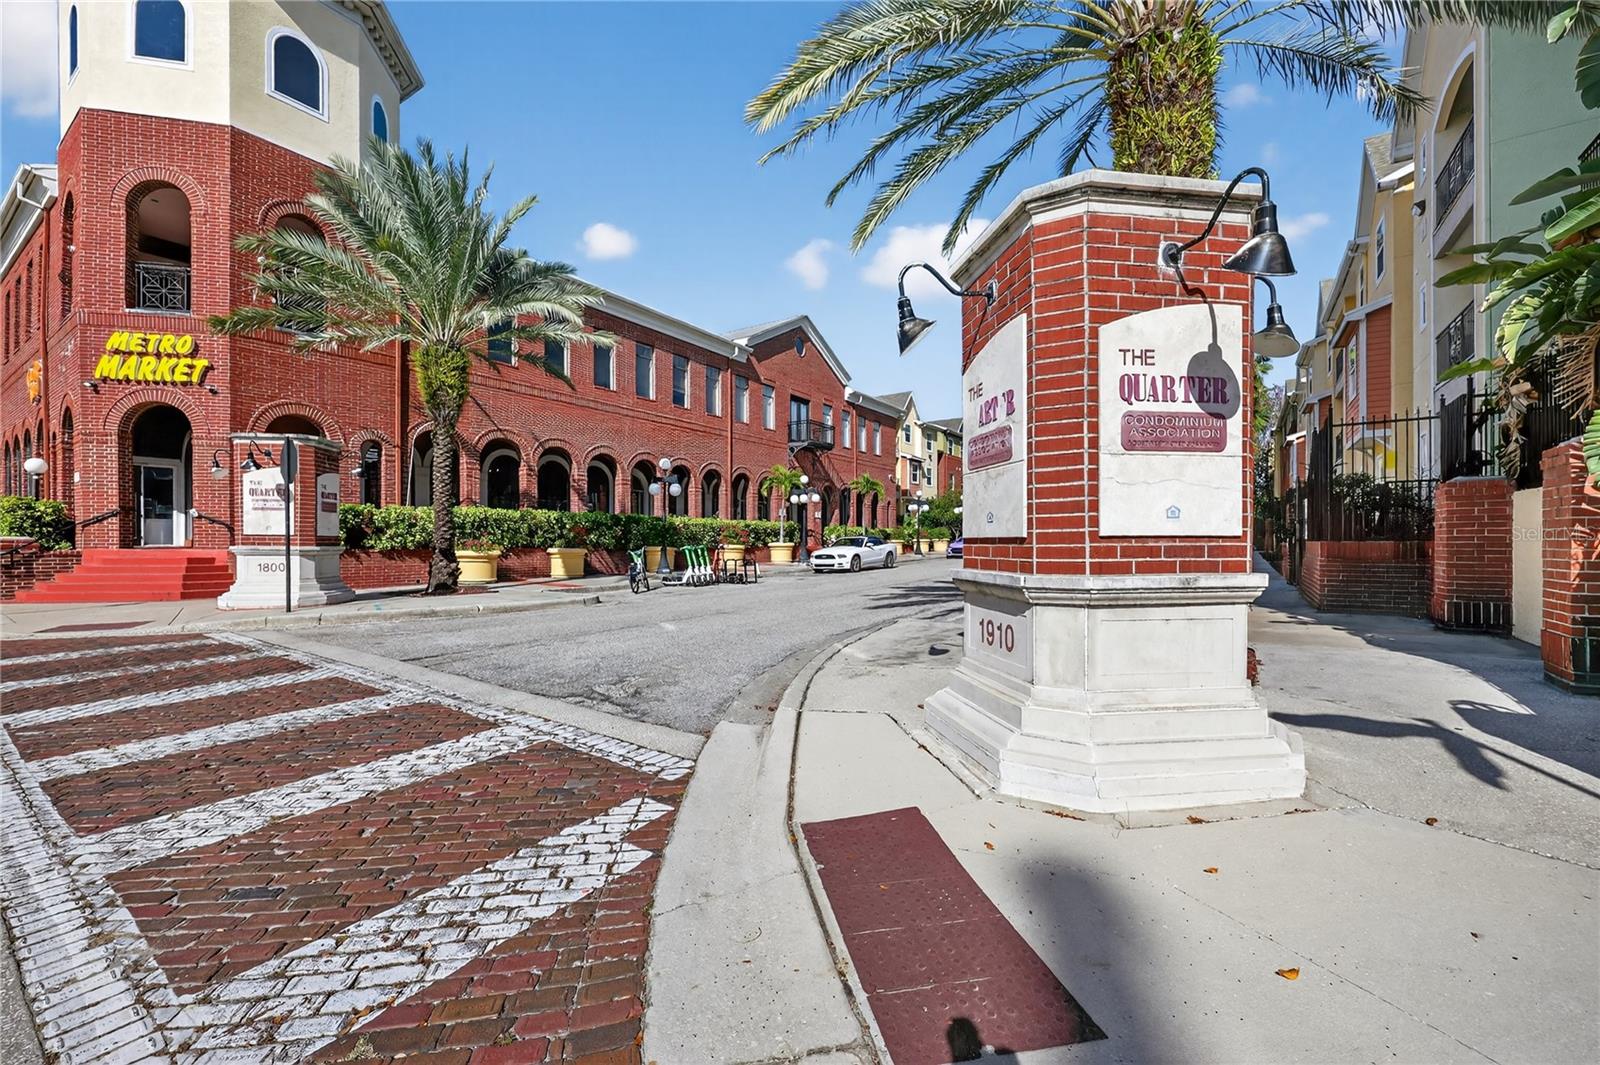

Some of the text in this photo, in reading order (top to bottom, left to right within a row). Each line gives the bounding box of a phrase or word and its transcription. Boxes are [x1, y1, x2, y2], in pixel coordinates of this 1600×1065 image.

[106, 331, 194, 355] METRO
[1118, 349, 1155, 366] THE
[95, 354, 209, 382] MARKET
[968, 382, 983, 402] THE
[1118, 373, 1230, 406] QUARTER
[1125, 415, 1223, 427] CONDOMINIUM
[1130, 427, 1220, 438] ASSOCIATION
[258, 562, 286, 573] 1800
[979, 618, 1014, 653] 1910
